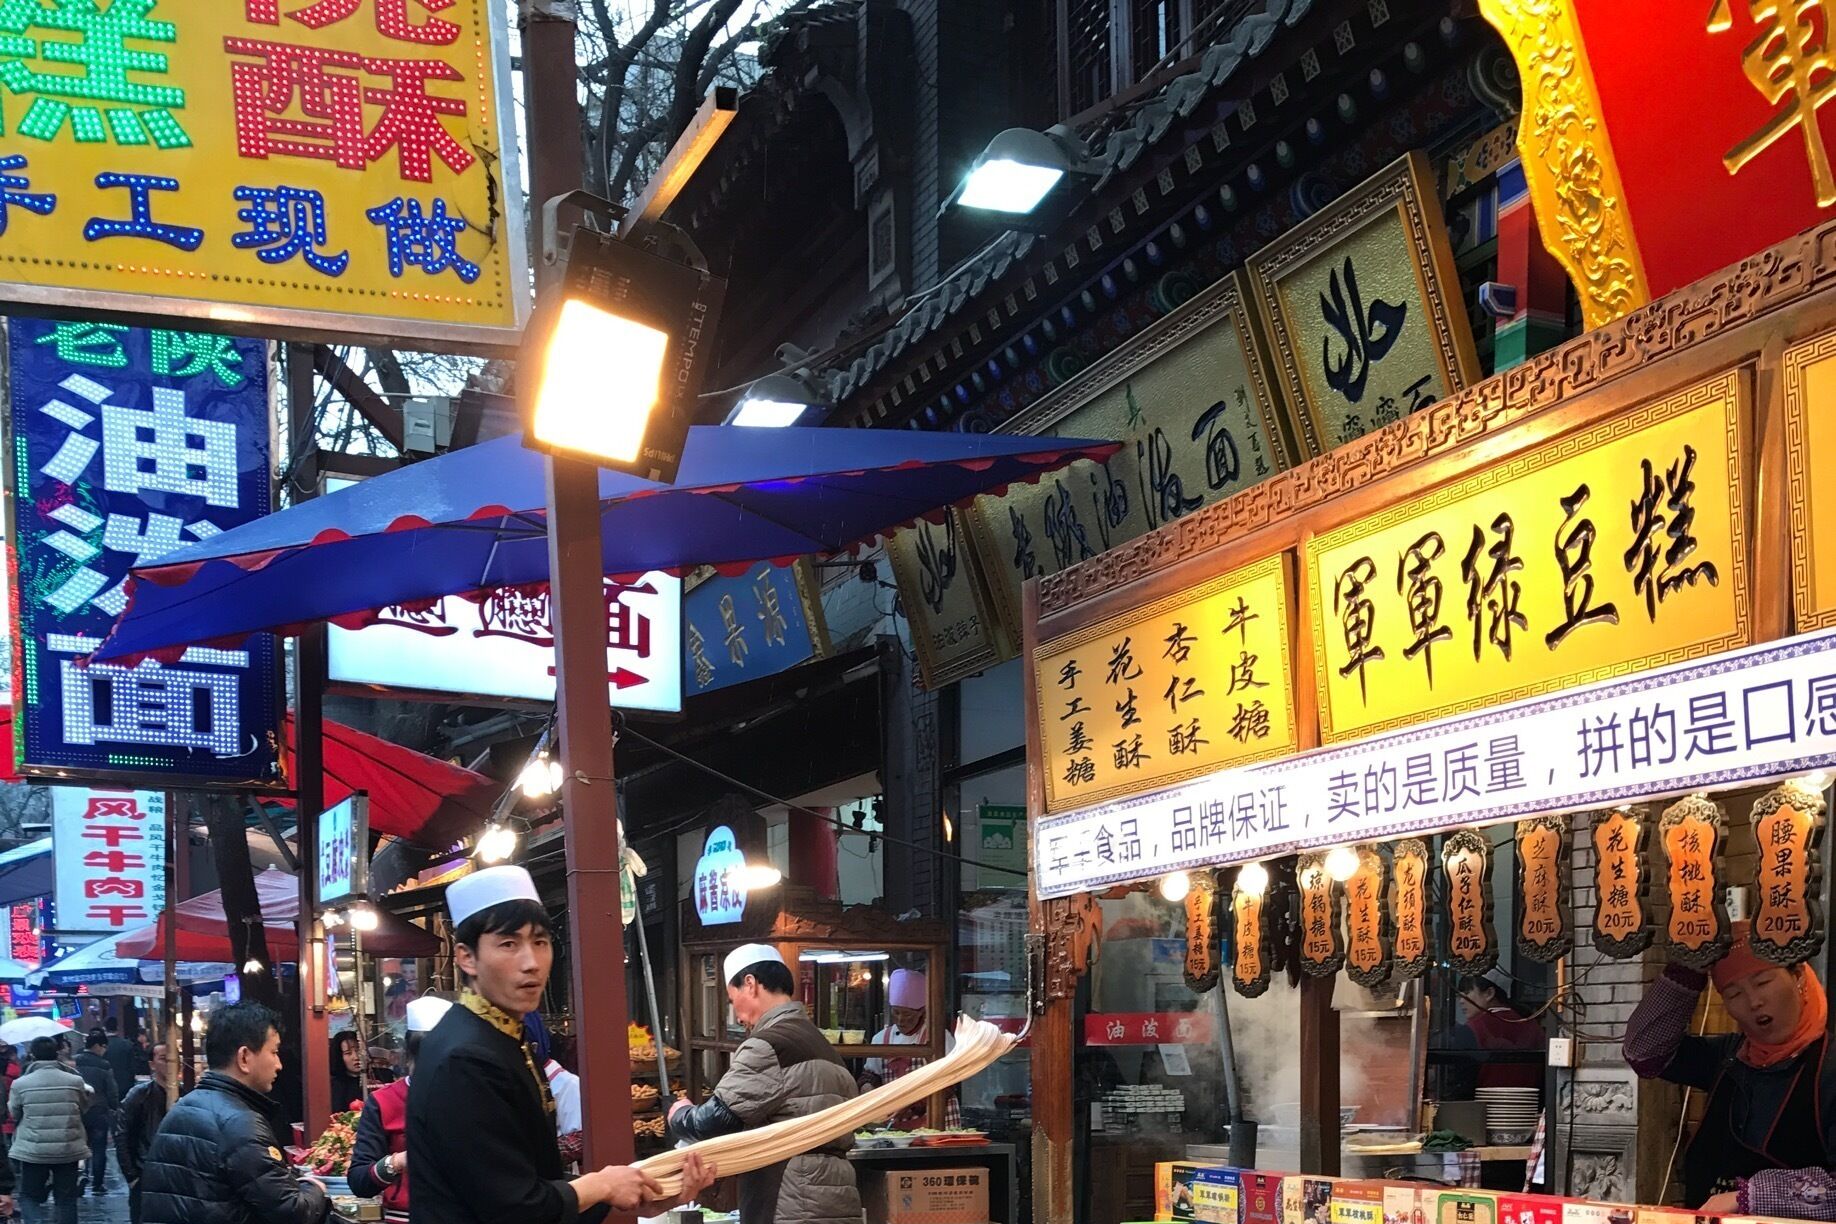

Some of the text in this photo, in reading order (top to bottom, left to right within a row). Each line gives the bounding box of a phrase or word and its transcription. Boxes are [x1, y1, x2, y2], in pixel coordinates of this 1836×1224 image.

[1162, 622, 1210, 756] 杏仁酥
[1221, 595, 1270, 744] 牛皮糖
[1058, 659, 1096, 787] 手工姜糖
[1105, 636, 1151, 770] 花生酥
[81, 787, 148, 927] 风干牛肉干
[1531, 839, 1550, 914] 芝麻酥
[1606, 827, 1630, 908] 花生糖
[1676, 829, 1706, 914] 核桃酥
[1768, 820, 1798, 908] 腰果酥
[1192, 895, 1204, 955] 手工姜糖
[1355, 877, 1373, 944] 花生酥
[1456, 857, 1476, 932] 瓜子仁酥
[1527, 917, 1555, 935] 20元
[1604, 909, 1634, 929] 20元
[1764, 915, 1801, 933] 20元
[1241, 896, 1255, 960] 牛皮糖
[1308, 939, 1330, 954] 15元
[1355, 949, 1377, 962] 15元
[1401, 937, 1420, 951] 15元
[1456, 935, 1481, 951] 20元
[1676, 918, 1711, 937] 20元
[1190, 958, 1206, 971] 15元
[1240, 962, 1257, 975] 15元
